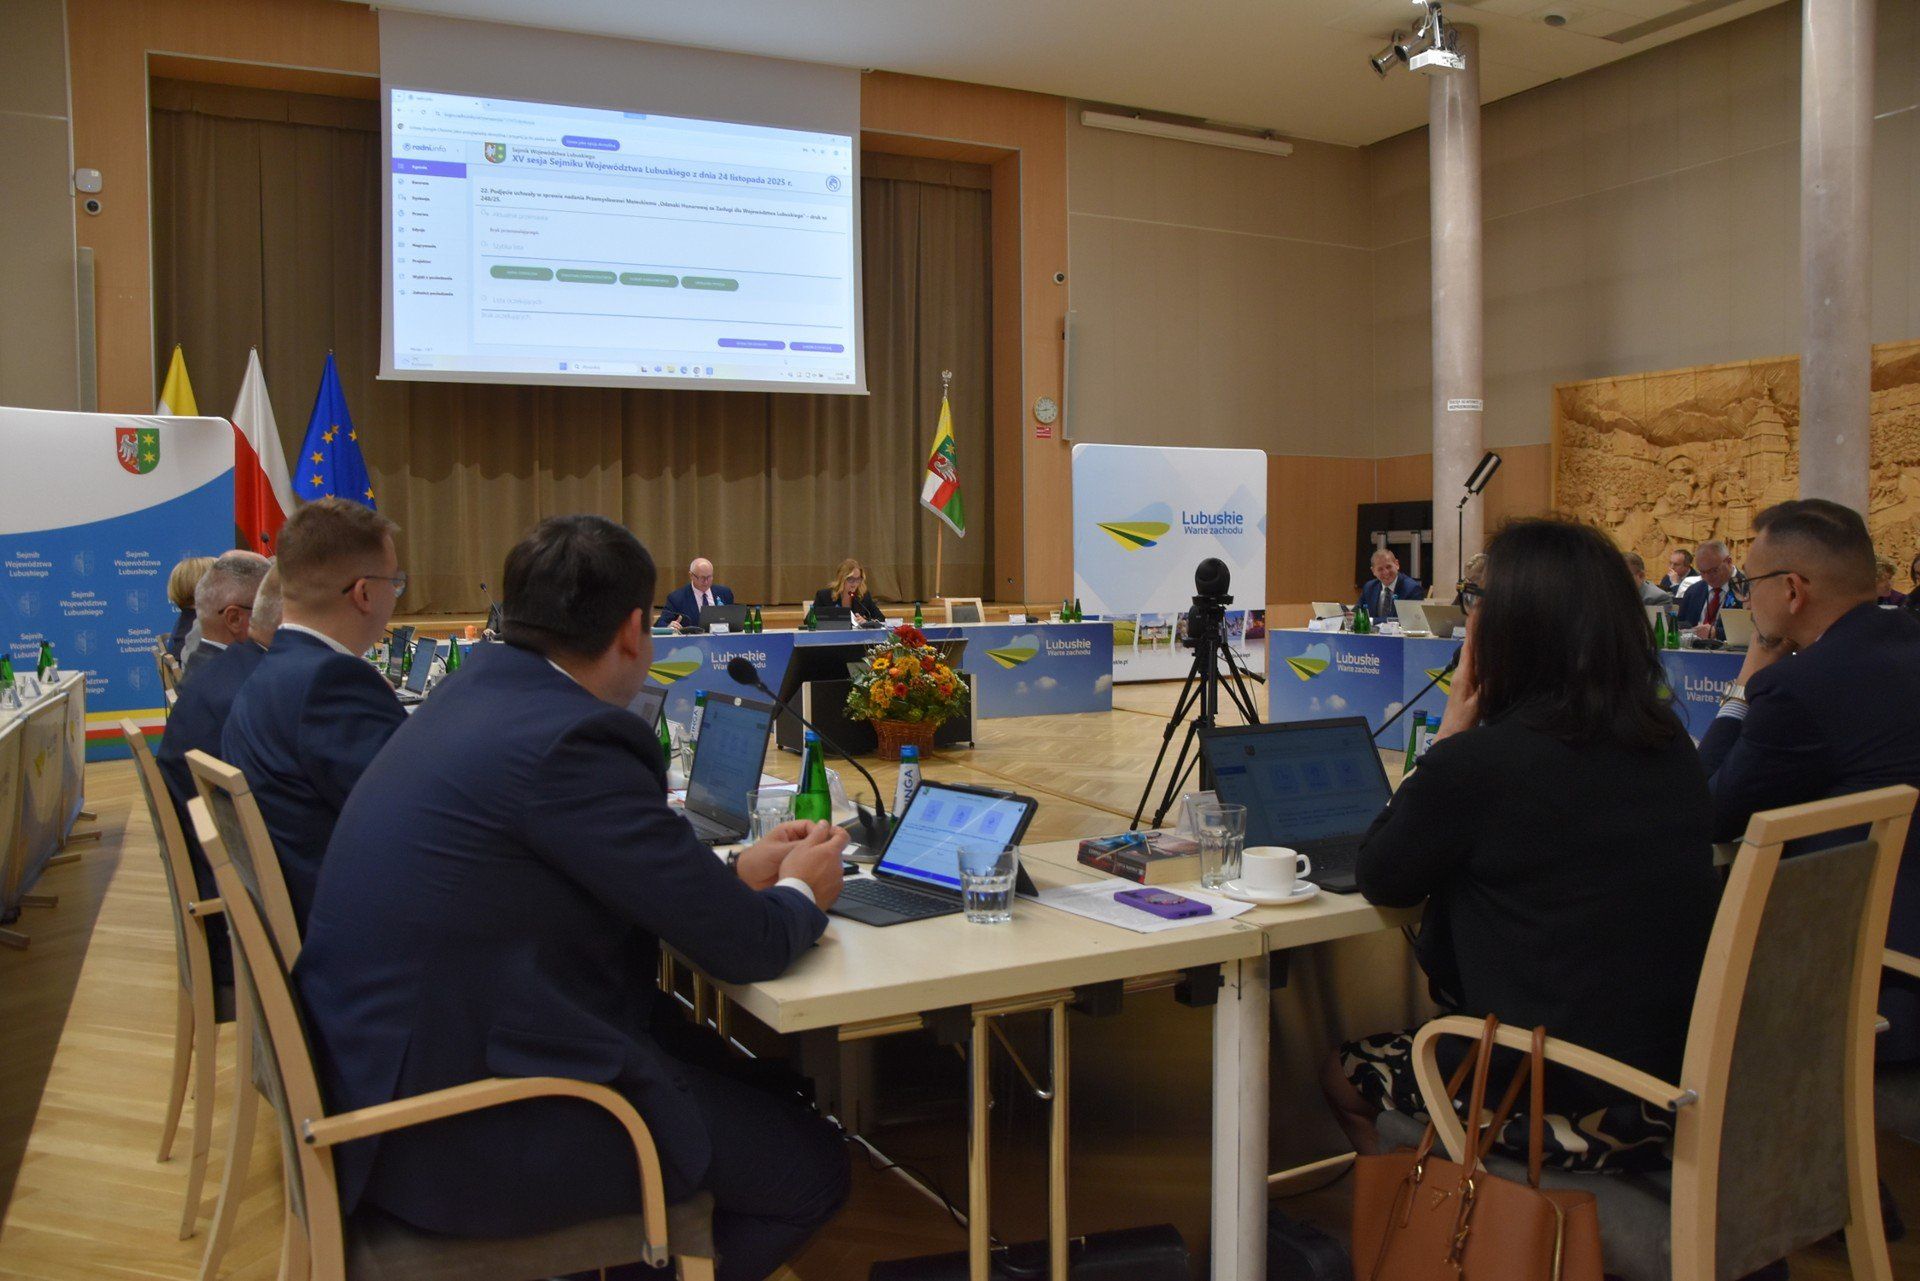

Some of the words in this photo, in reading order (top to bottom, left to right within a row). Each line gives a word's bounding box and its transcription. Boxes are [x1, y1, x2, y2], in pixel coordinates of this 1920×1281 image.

[512, 154, 524, 163] XV
[527, 157, 547, 166] sesja
[549, 158, 583, 168] Sejmiku
[585, 161, 643, 173] Województwa
[645, 166, 691, 178] Lubuskiego
[699, 171, 716, 180] dnia
[718, 173, 728, 181] 24
[730, 173, 765, 184] listopada
[767, 177, 785, 186] 2025
[1182, 511, 1243, 525] Lubuskie
[1184, 526, 1208, 534] Warte
[1209, 526, 1243, 535] zachodu
[16, 552, 40, 560] Sejmik
[125, 551, 150, 559] Sejmik
[5, 560, 52, 568] Województwa
[114, 559, 161, 568] Województwa
[9, 569, 49, 578] Lubuskiego
[119, 568, 157, 576] Lubuskiego
[71, 591, 95, 599] Sejmik
[60, 600, 107, 608] Województwa
[64, 608, 104, 617] Lubuskiego
[128, 628, 151, 636] Sejmik
[1046, 638, 1091, 649] Lubuskie
[1336, 651, 1380, 666] Lubuskie
[1337, 664, 1354, 673] Warte
[1354, 666, 1380, 675] zachodu
[1686, 691, 1714, 702] Warte
